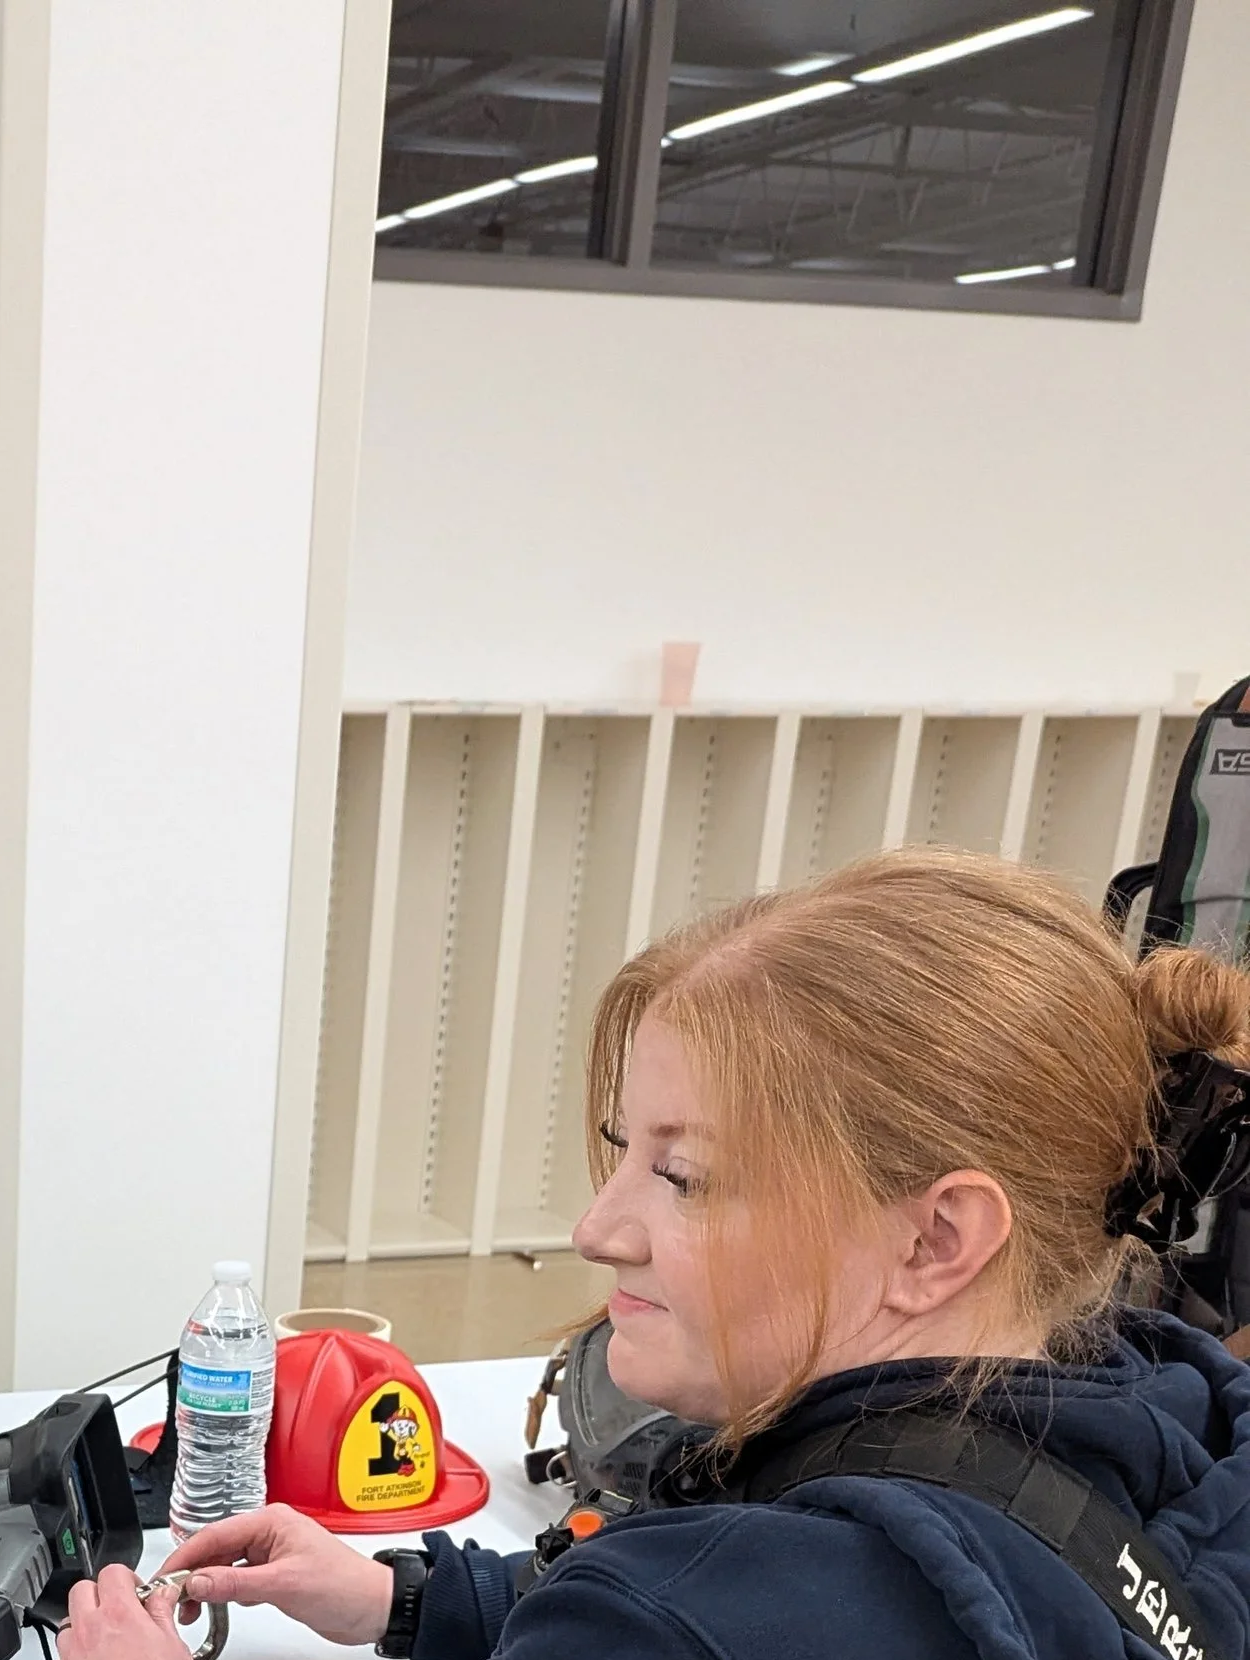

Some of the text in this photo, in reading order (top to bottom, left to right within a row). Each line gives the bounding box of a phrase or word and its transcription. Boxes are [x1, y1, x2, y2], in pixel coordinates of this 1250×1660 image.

[209, 1375, 233, 1383] WATER
[189, 1392, 216, 1403] RECYCLE
[368, 1392, 401, 1476] 1
[356, 1485, 425, 1502] FIRE DEPARTMENT
[362, 1480, 422, 1494] FORT ATKINSON
